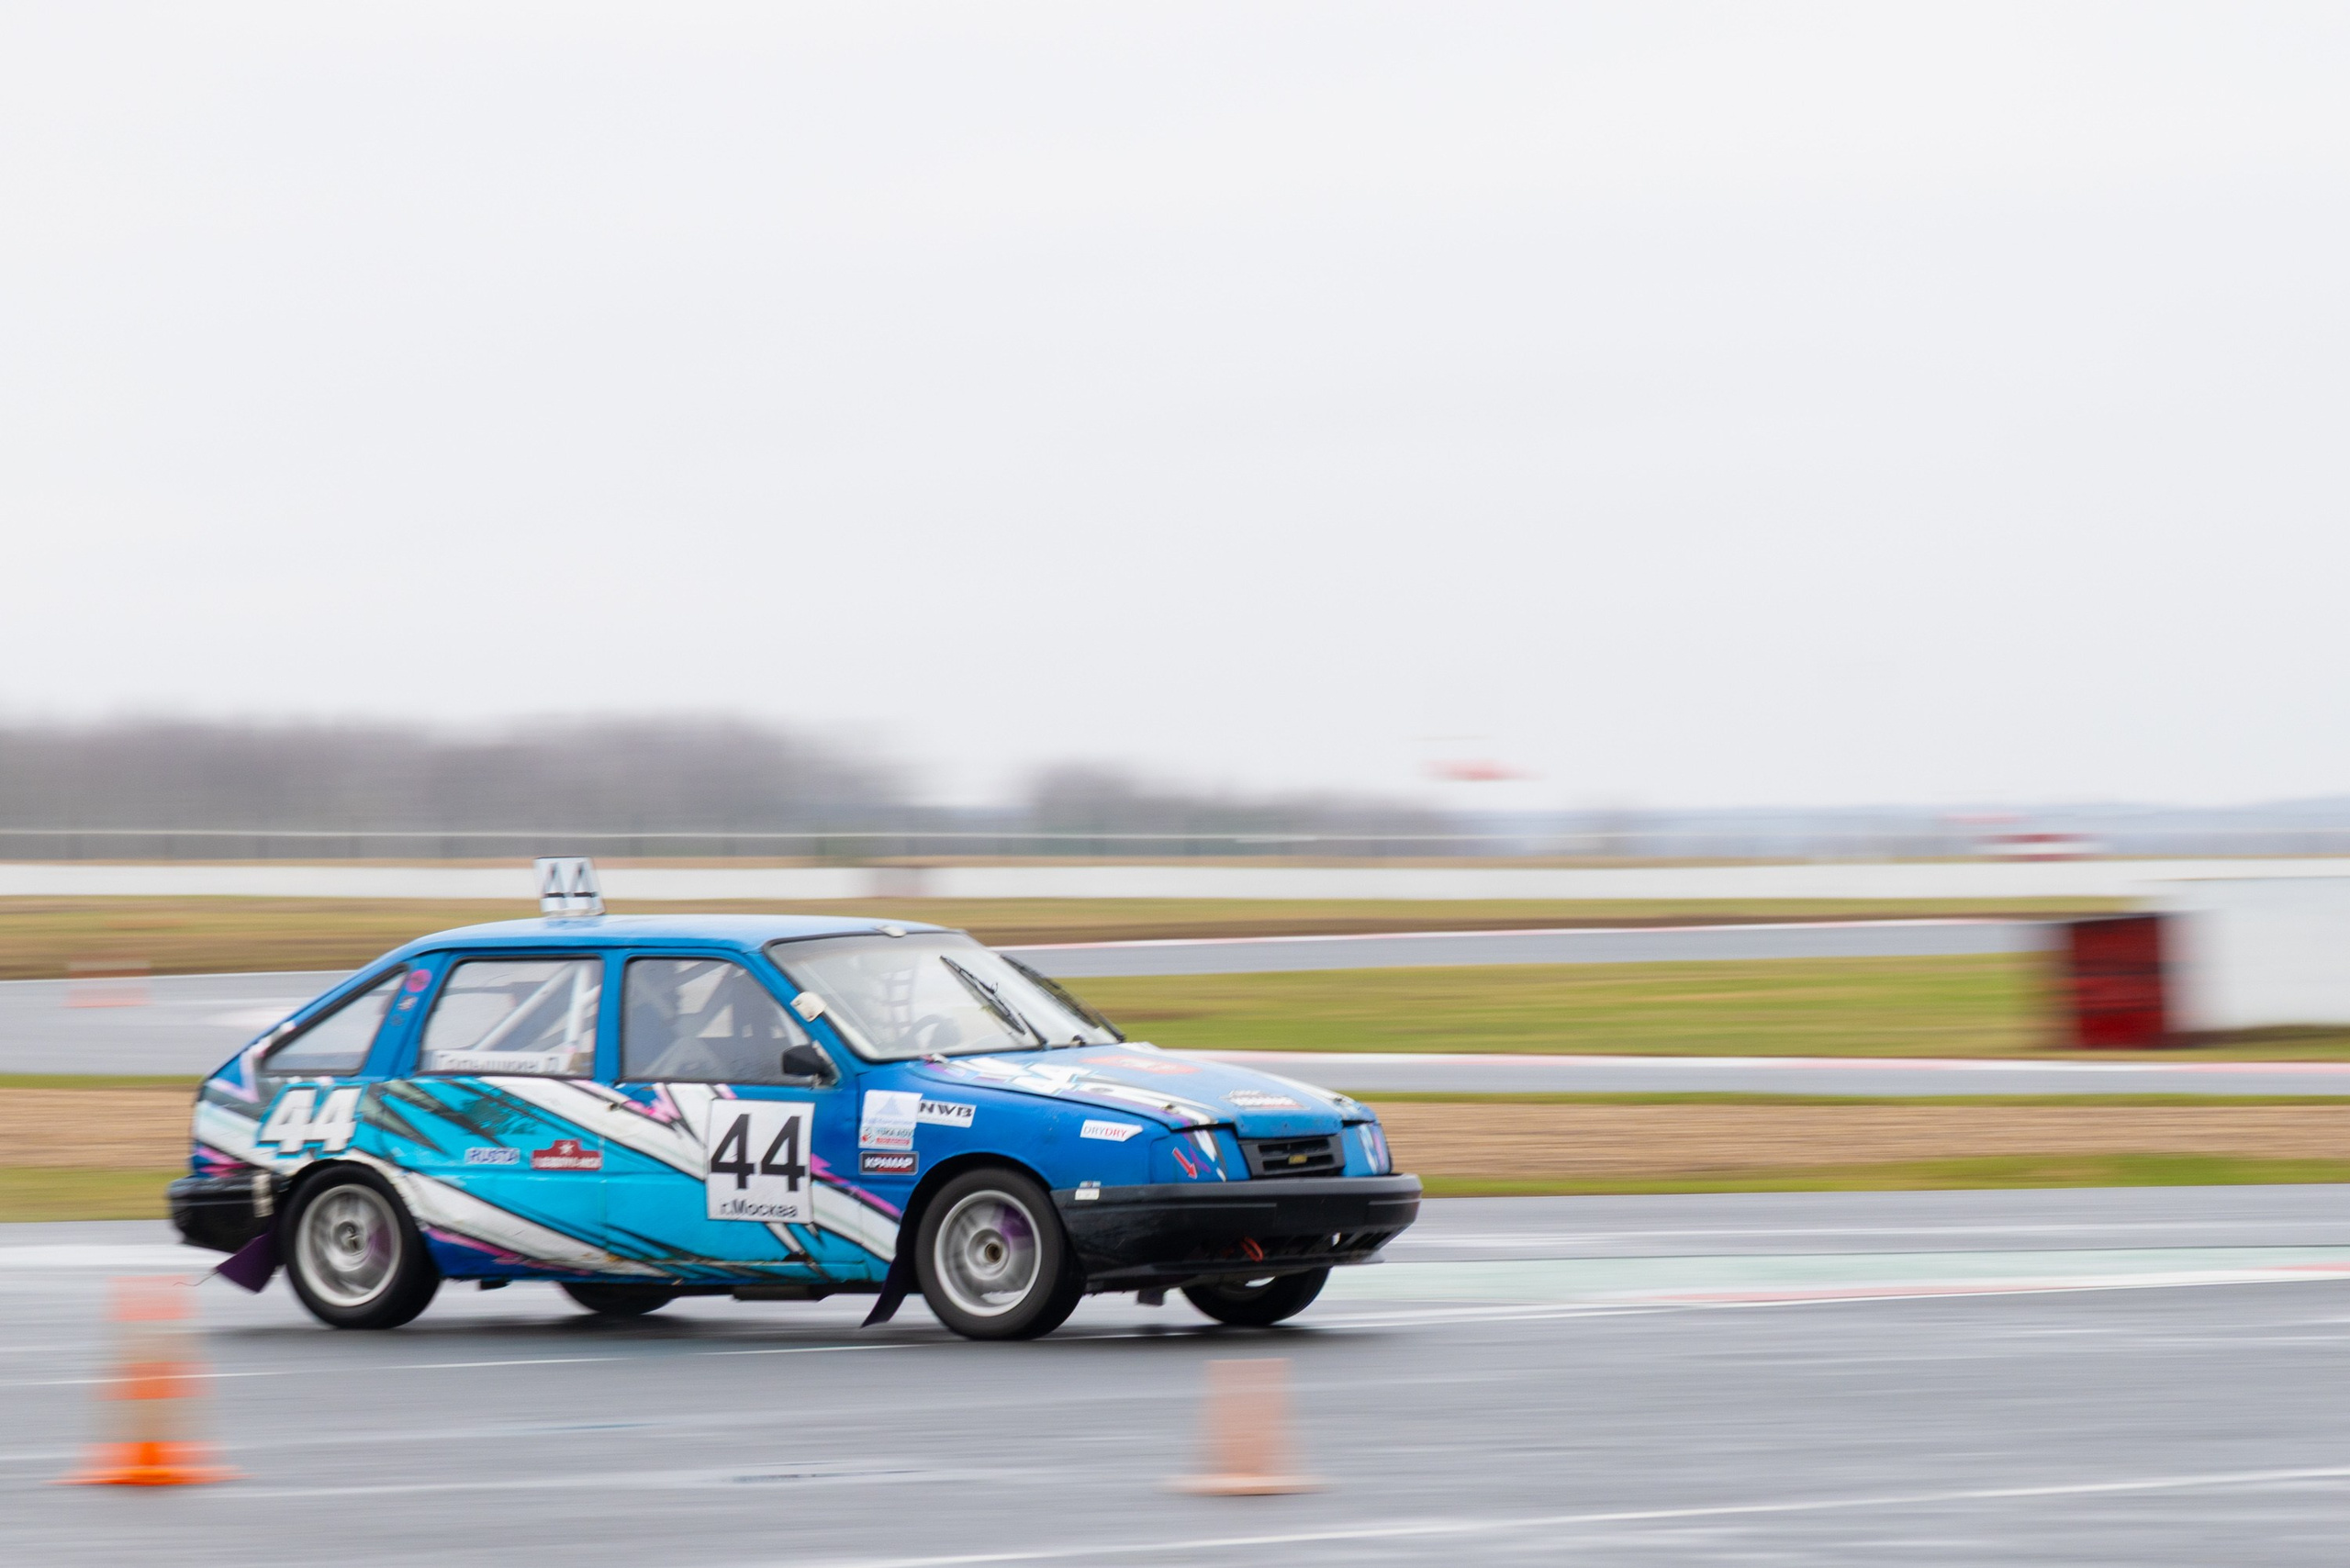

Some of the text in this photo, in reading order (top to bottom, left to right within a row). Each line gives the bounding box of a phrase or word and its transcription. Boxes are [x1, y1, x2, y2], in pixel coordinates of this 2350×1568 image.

[543, 861, 598, 909] 44
[257, 1085, 364, 1154] 44
[920, 1103, 973, 1118] NWB
[1083, 1125, 1127, 1138] DRYDRY
[711, 1113, 806, 1193] 44
